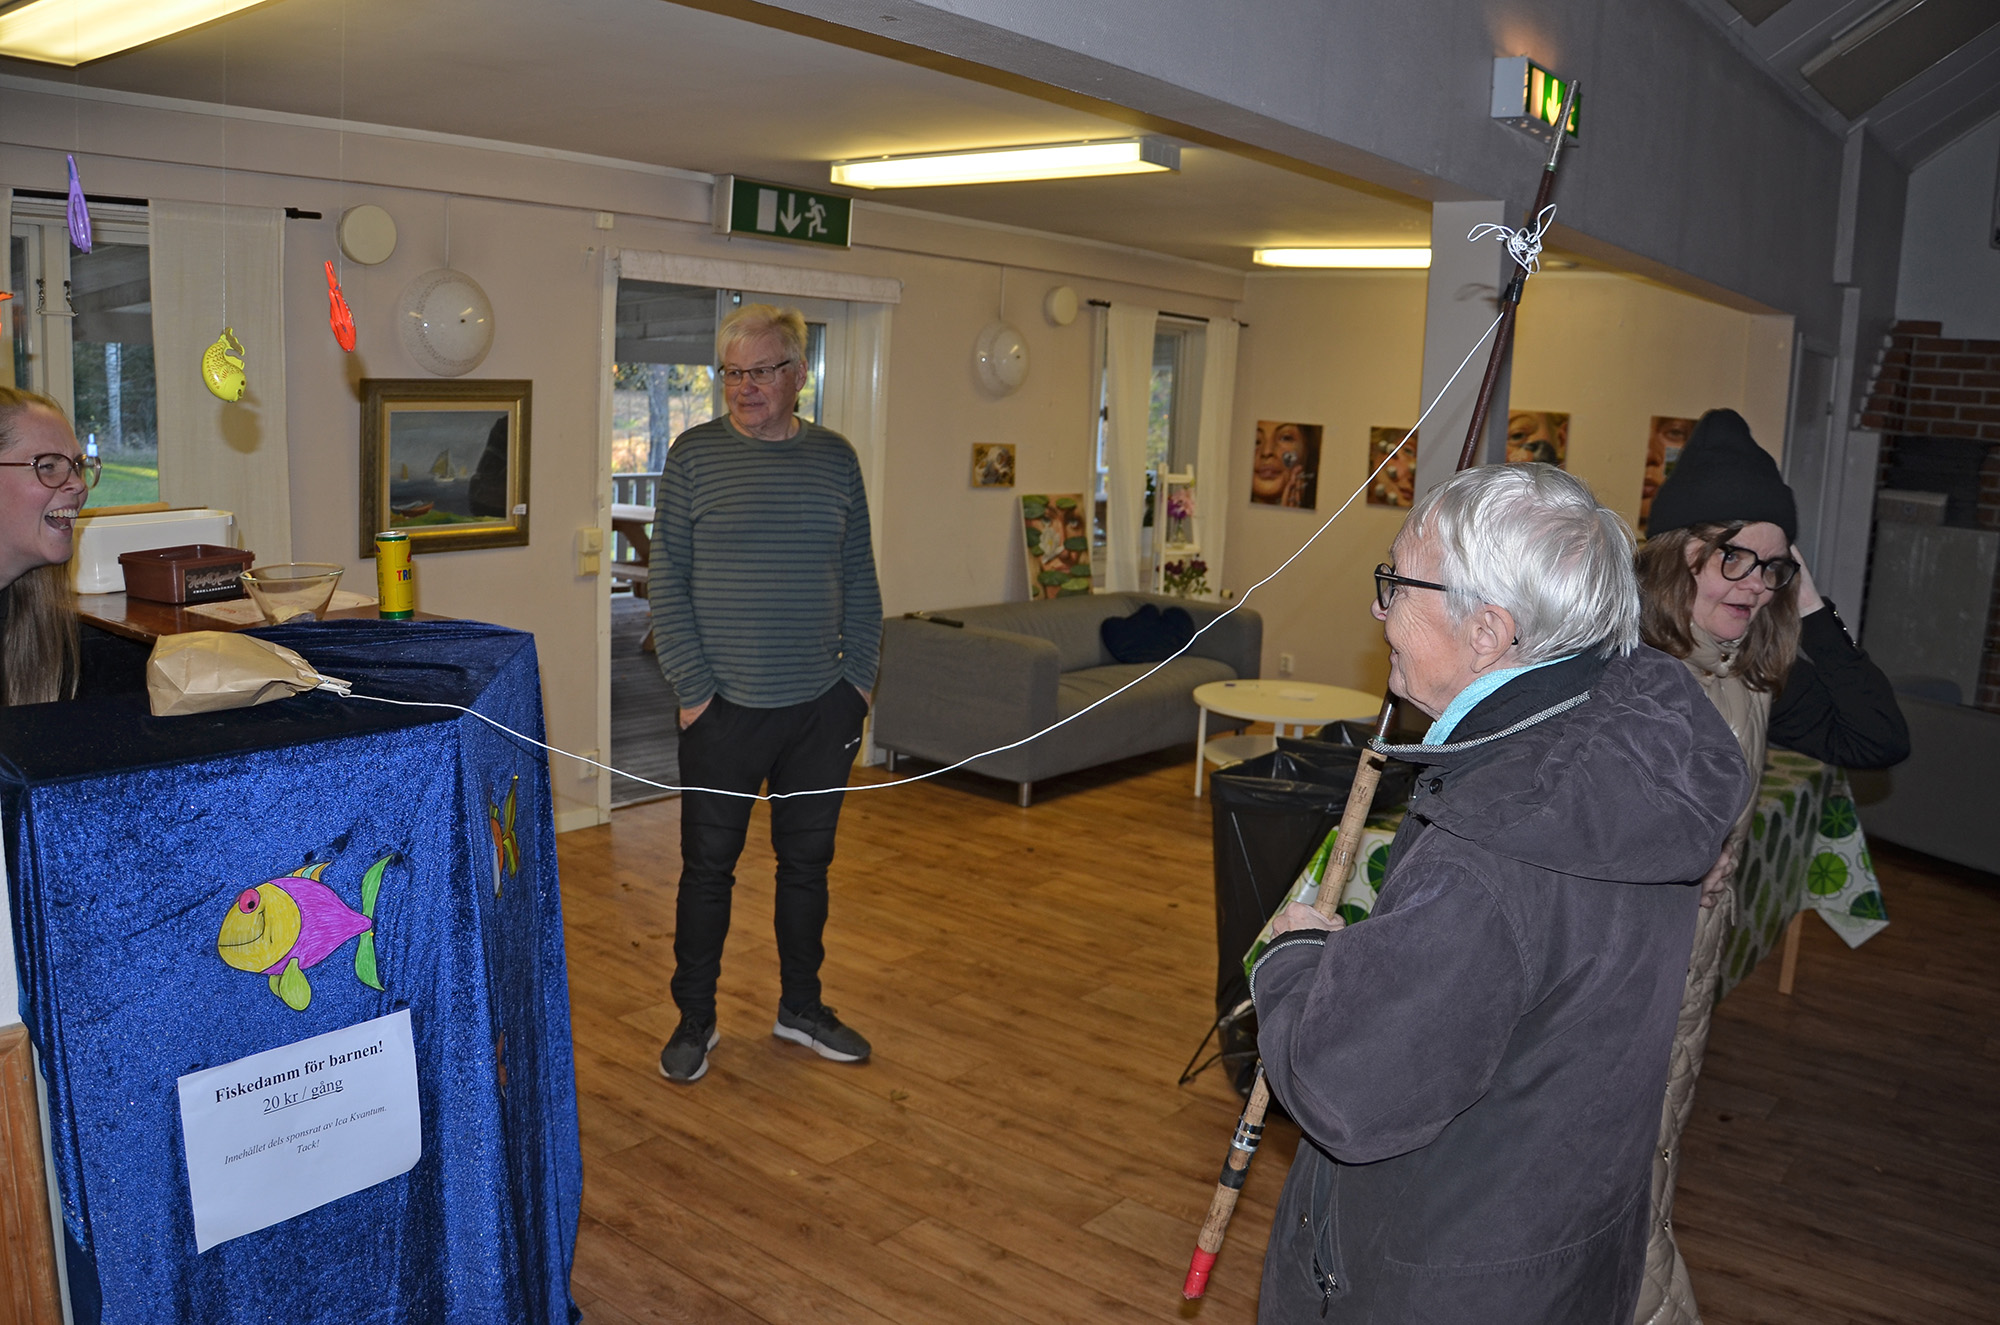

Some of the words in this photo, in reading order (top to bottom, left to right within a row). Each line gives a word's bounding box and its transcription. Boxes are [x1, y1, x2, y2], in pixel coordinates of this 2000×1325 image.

[215, 1068, 300, 1103] Fiskedamm
[304, 1059, 325, 1075] för
[329, 1040, 383, 1067] barnen!
[263, 1098, 280, 1112] 20
[284, 1092, 299, 1106] kr
[301, 1086, 308, 1100] /
[311, 1079, 344, 1100] gång
[224, 1143, 267, 1165] Innehållet
[267, 1137, 285, 1149] dels
[286, 1125, 322, 1144] sponsrat
[323, 1121, 334, 1131] av
[334, 1117, 348, 1128] Ica
[349, 1105, 387, 1122] Kvantum.
[297, 1139, 320, 1154] Tack!
